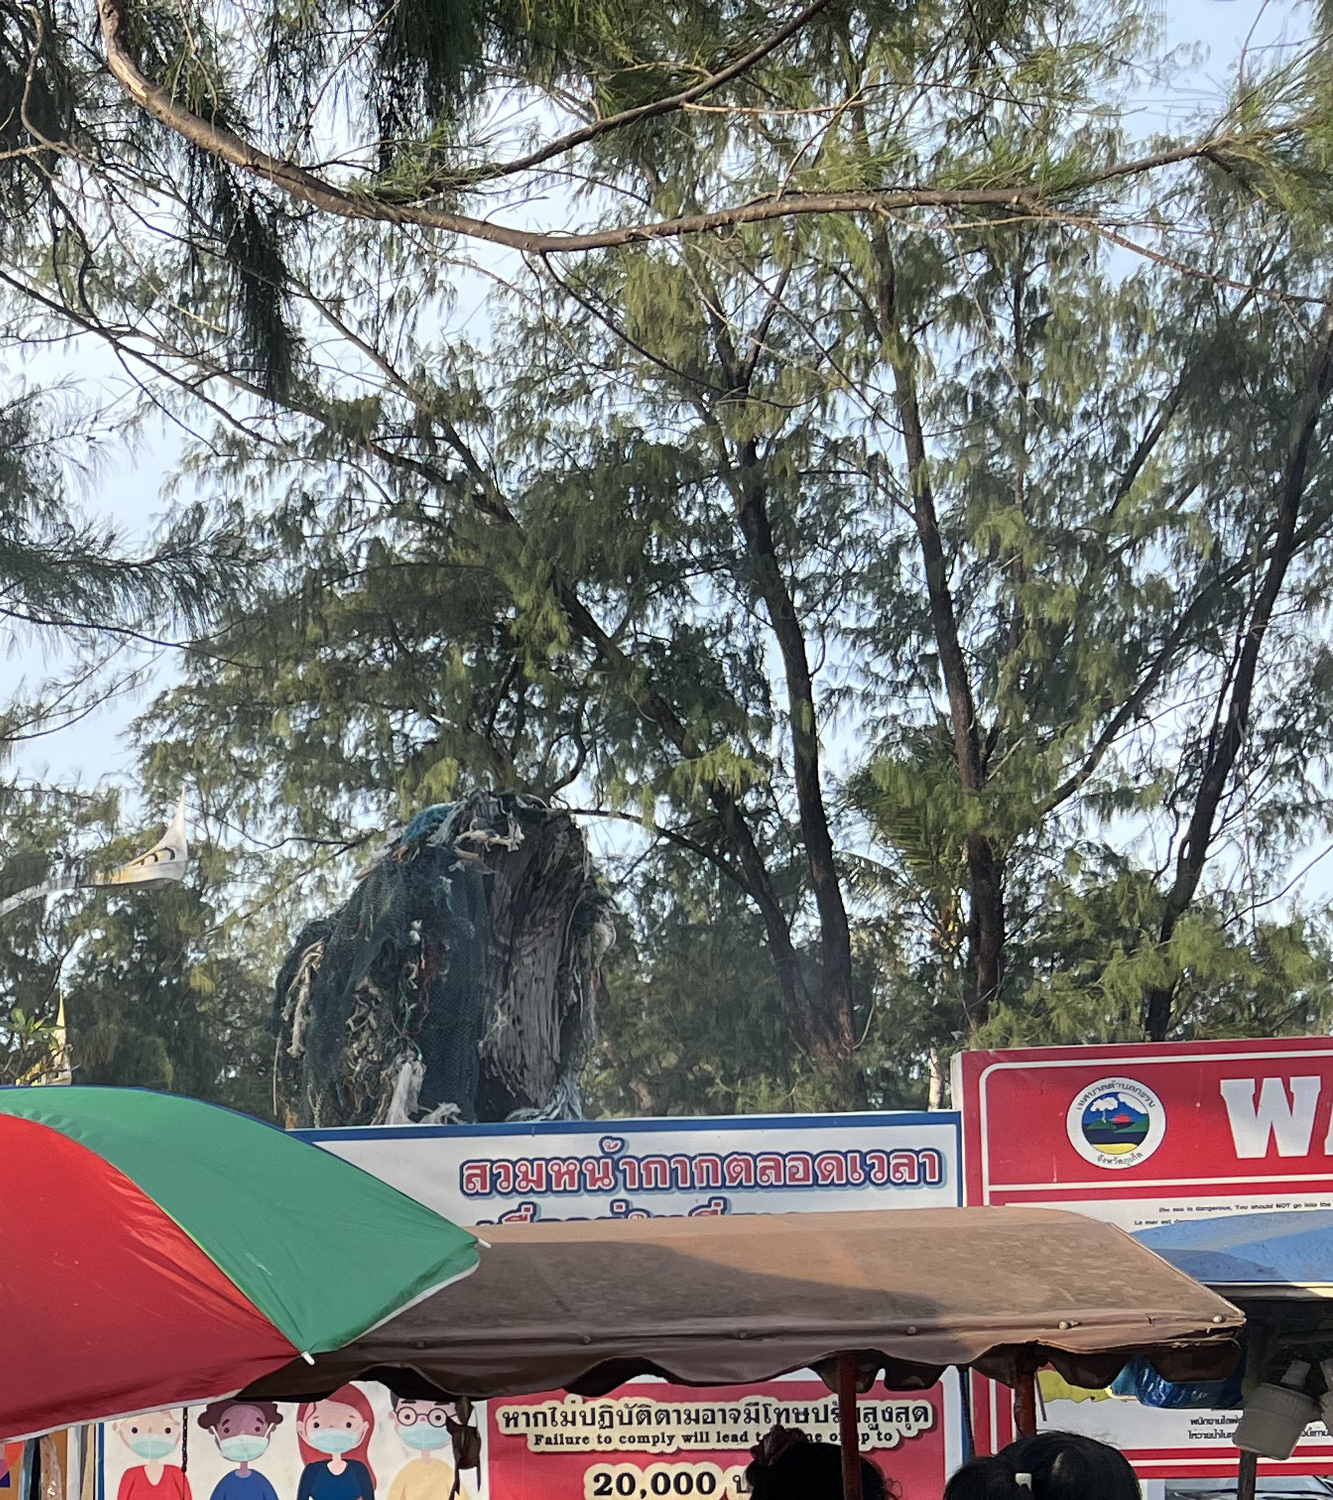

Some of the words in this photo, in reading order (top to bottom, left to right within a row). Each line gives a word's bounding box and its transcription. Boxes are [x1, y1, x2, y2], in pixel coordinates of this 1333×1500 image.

[462, 1137, 939, 1192] สวมหน้ากากตลอดเวลา
[533, 1433, 591, 1446] Failure
[596, 1434, 613, 1446] to
[618, 1433, 675, 1449] comply
[682, 1431, 710, 1445] will
[716, 1430, 749, 1444] lead
[876, 1430, 893, 1443] to
[592, 1470, 718, 1500] 20,000
